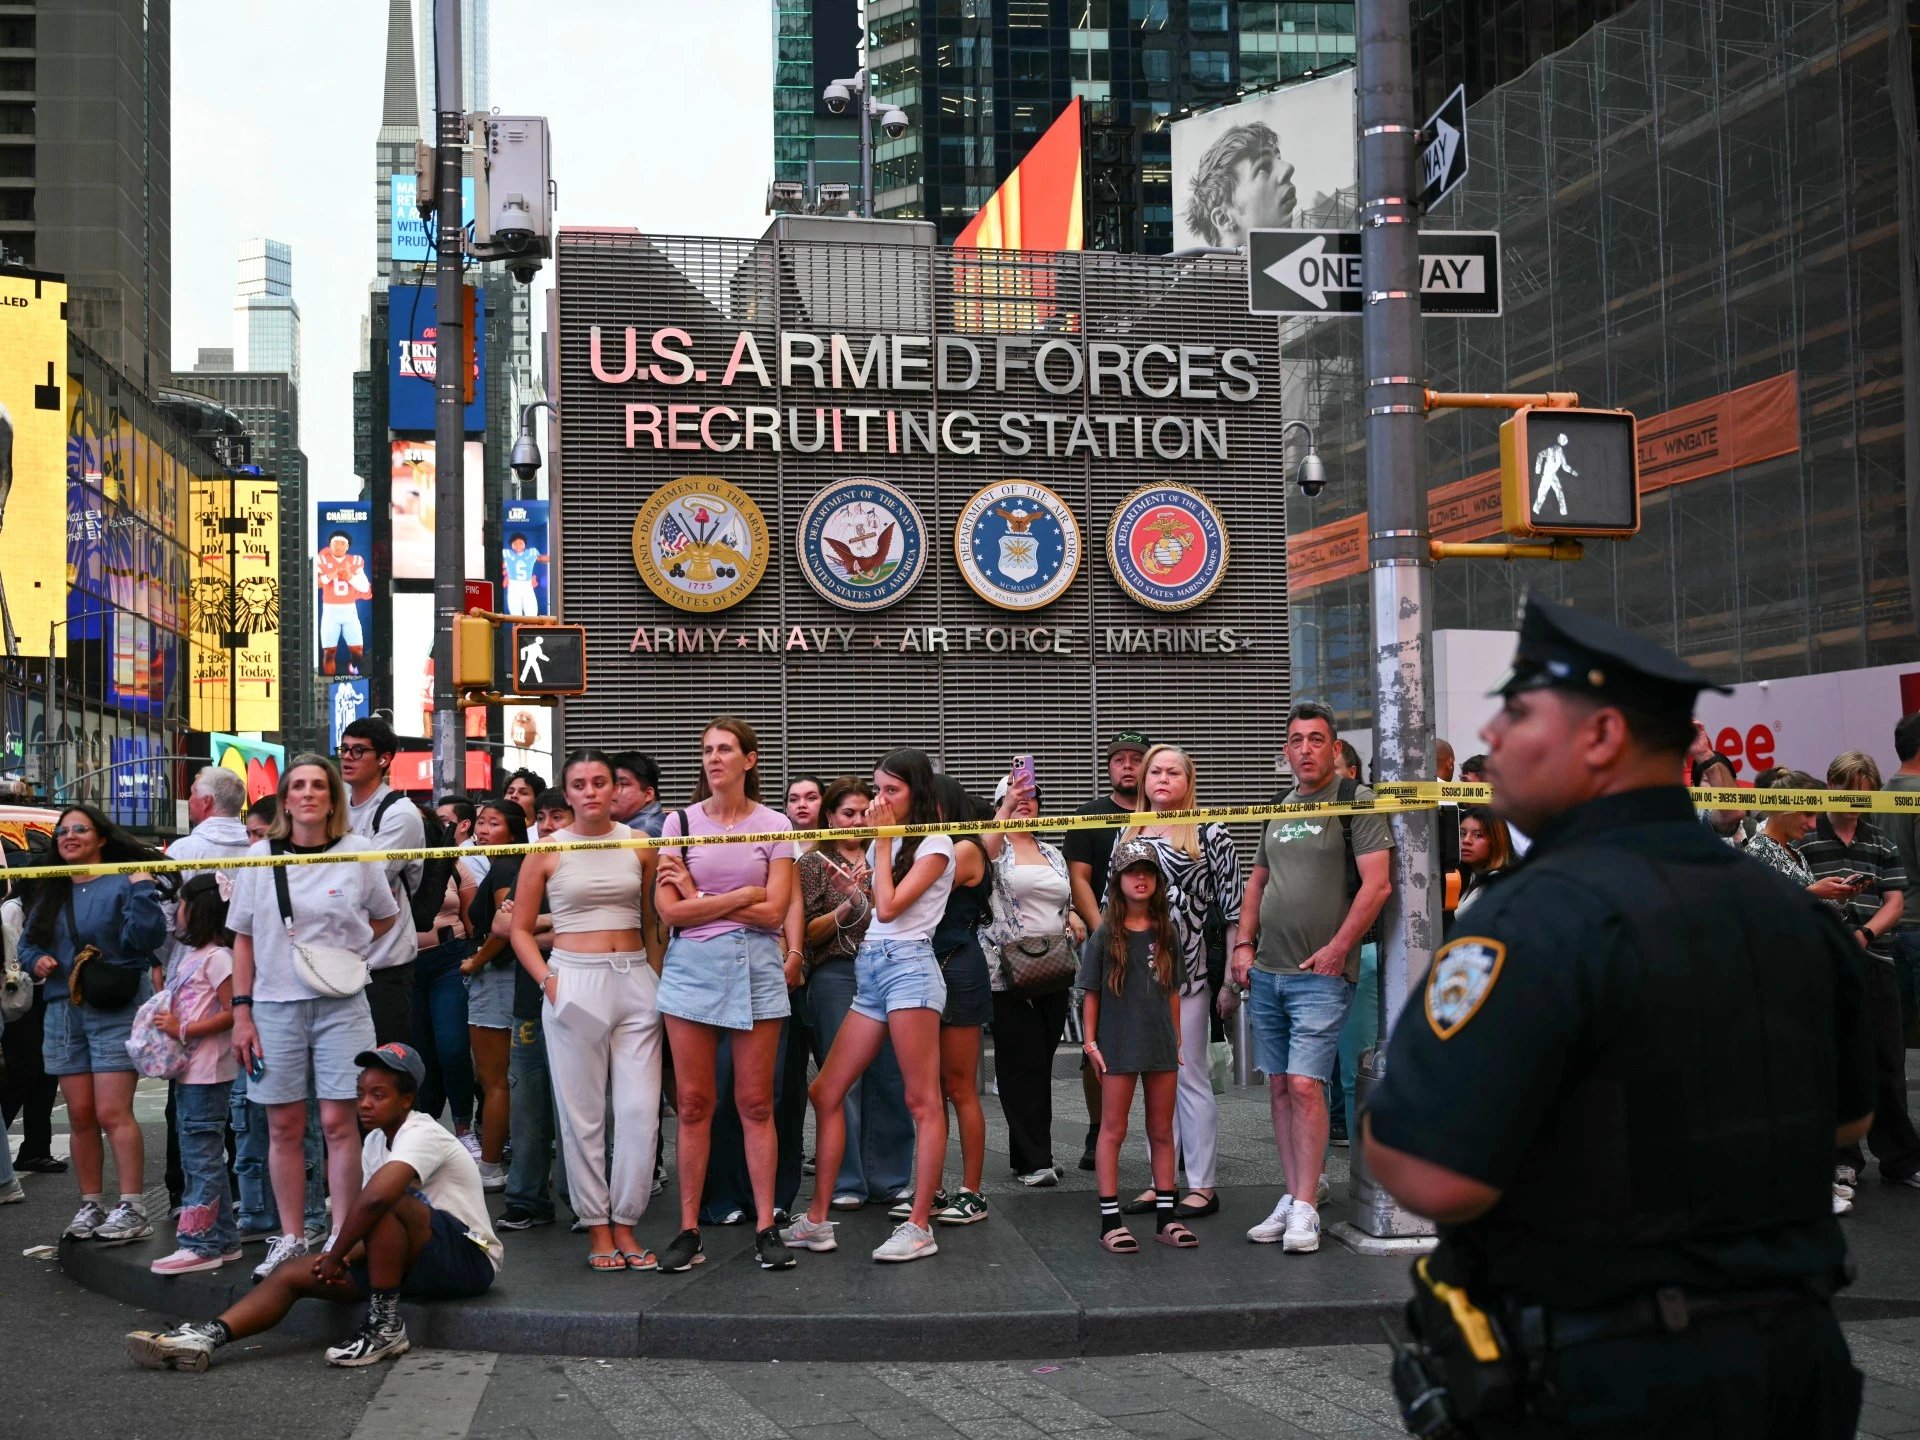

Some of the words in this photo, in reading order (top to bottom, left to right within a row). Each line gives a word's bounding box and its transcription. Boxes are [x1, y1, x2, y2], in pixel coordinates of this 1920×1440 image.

[1423, 133, 1446, 184] WAY
[398, 236, 428, 246] PRUD
[1300, 257, 1362, 288] ONE
[1420, 259, 1470, 288] AY
[0, 296, 28, 307] LED
[590, 326, 707, 385] U.S.
[721, 331, 982, 391] ARMED
[996, 337, 1259, 401] FORCES
[626, 404, 980, 456] RECRUITING
[999, 411, 1228, 460] STATION
[1664, 427, 1717, 456] WINGATE
[252, 491, 261, 504] It
[1473, 494, 1502, 512] WINGA
[240, 507, 273, 521] Lives
[326, 512, 367, 520] CHAMBLISS
[641, 482, 700, 532] DEPARTMENT
[708, 484, 722, 493] OF
[726, 490, 746, 508] THE
[746, 512, 764, 543] ARMY
[809, 490, 856, 540] DEPARTMENT
[860, 490, 874, 498] OF
[879, 494, 896, 510] THE
[897, 507, 915, 533] NAVY
[1118, 494, 1166, 546] DEPARTMENT
[1182, 498, 1198, 510] THE
[1197, 510, 1217, 539] NAVY
[250, 524, 262, 537] in
[960, 491, 995, 562] DEPARTMENT
[1002, 485, 1018, 495] OF
[1025, 486, 1049, 502] THE
[1051, 505, 1069, 524] AIR
[1064, 530, 1076, 571] FORCE
[243, 540, 266, 554] You
[1329, 537, 1360, 556] WINGATE
[640, 544, 662, 587] UNITED
[664, 588, 708, 606] STATES
[713, 596, 727, 606] OF
[730, 552, 763, 598] AMERICA
[809, 553, 835, 588] UNITED
[835, 585, 871, 599] STATES
[874, 586, 887, 596] OF
[889, 549, 916, 590] AMERICA
[1122, 556, 1144, 587] UNITED
[1145, 585, 1174, 598] STATES
[1177, 577, 1206, 596] MARINE
[1205, 549, 1217, 576] CORPS
[465, 586, 480, 594] PING
[995, 591, 1018, 603] STATES
[630, 627, 727, 653] ARMY
[758, 626, 856, 653] NAVY
[900, 627, 949, 652] AIR
[966, 627, 1073, 654] FORCE
[1106, 627, 1235, 653] MARINES
[241, 651, 260, 663] See
[264, 651, 272, 663] it
[239, 665, 275, 678] Today.
[1442, 787, 1461, 796] CROSS
[1463, 787, 1474, 797] NOT
[1476, 788, 1484, 797] DO
[1704, 793, 1712, 802] DO
[1718, 793, 1737, 803] SCENE
[1739, 794, 1756, 804] CRIME
[1760, 794, 1777, 805] (8477)
[1779, 795, 1823, 805] 1-800-577-TIPS
[1894, 796, 1913, 806] CROSS
[1252, 805, 1272, 815] (8477)
[1273, 802, 1322, 813] 1-800-577-TIPS
[981, 821, 1000, 829] CRIME
[1004, 819, 1024, 829] (8477)
[1026, 817, 1075, 828] 1-800-577-TIPS
[905, 825, 926, 833] CROSS
[703, 836, 723, 844] SCENE
